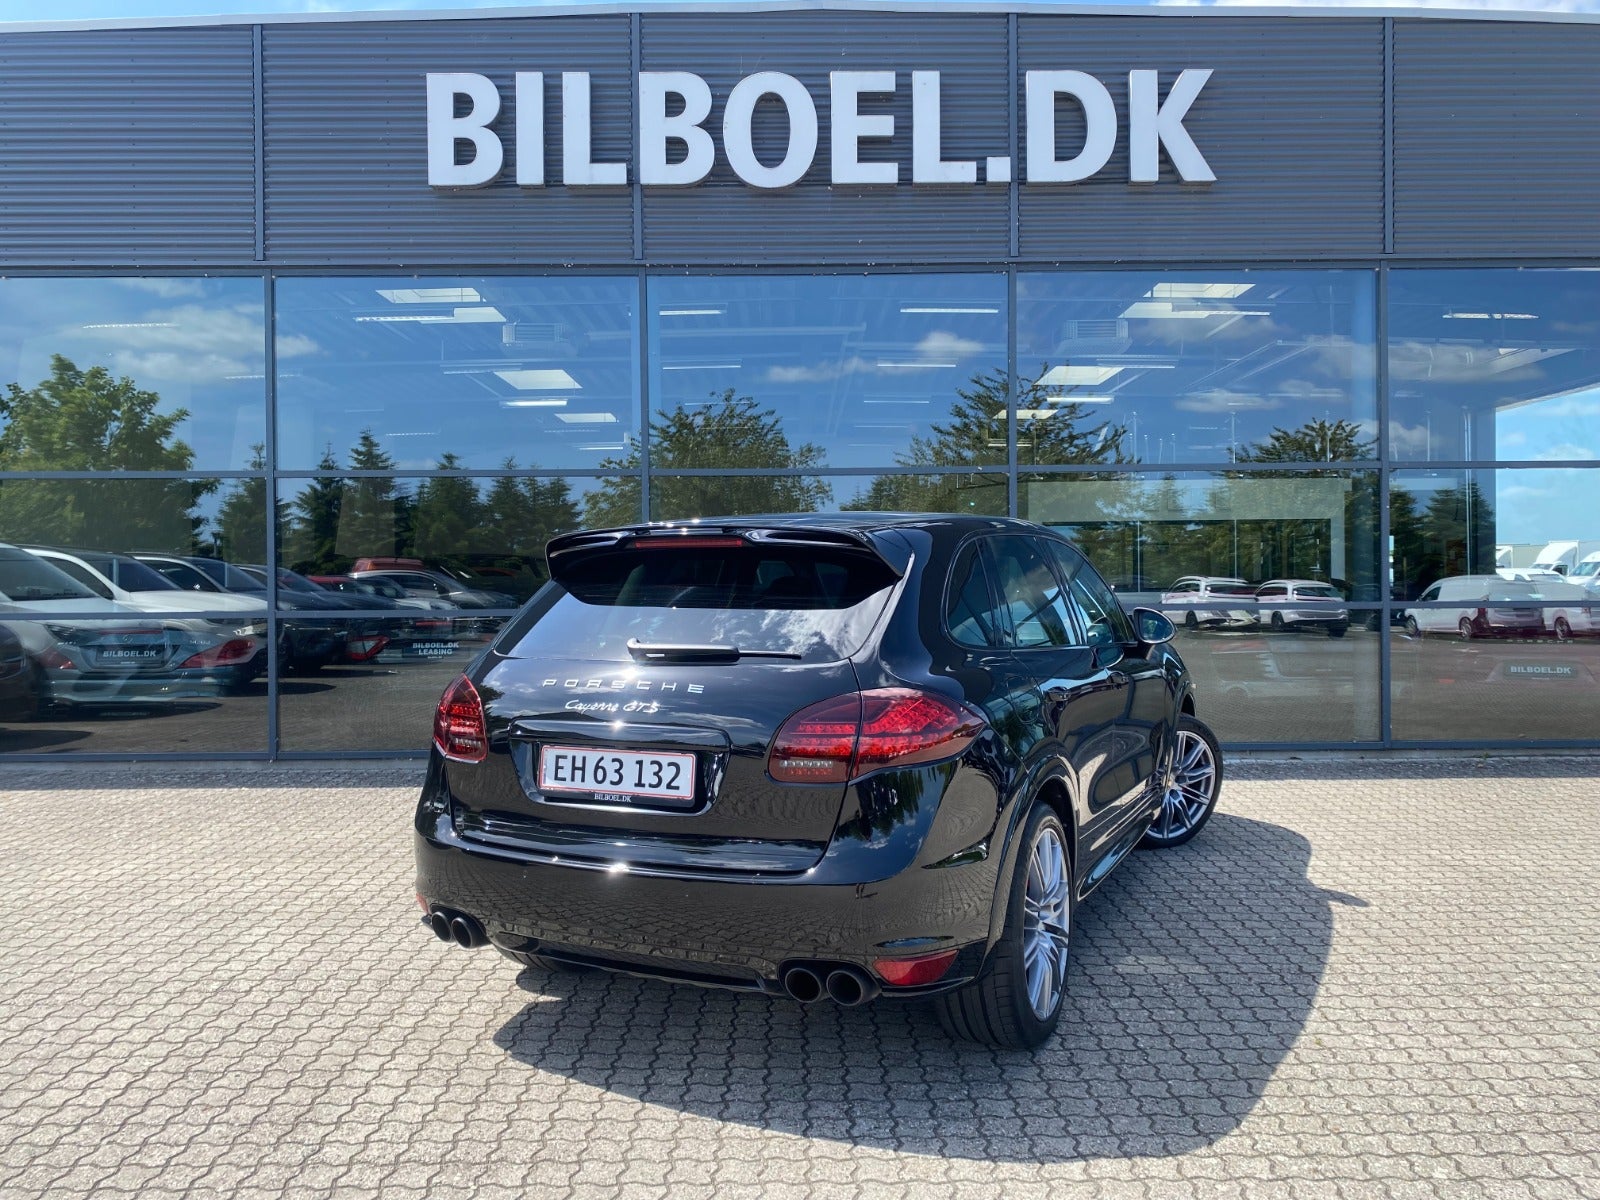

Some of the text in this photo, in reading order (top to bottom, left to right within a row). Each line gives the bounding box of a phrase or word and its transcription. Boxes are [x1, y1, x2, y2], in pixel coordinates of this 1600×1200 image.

[426, 69, 1217, 189] BILBOEL.DK
[102, 650, 157, 658] BILBOEL.DK
[1510, 666, 1571, 674] BILBOEL.DK
[542, 679, 705, 694] PORSCHE
[564, 699, 661, 714] Cayenne GTS
[553, 754, 681, 791] EH 63 132
[594, 793, 632, 803] BILBOEL.DK
